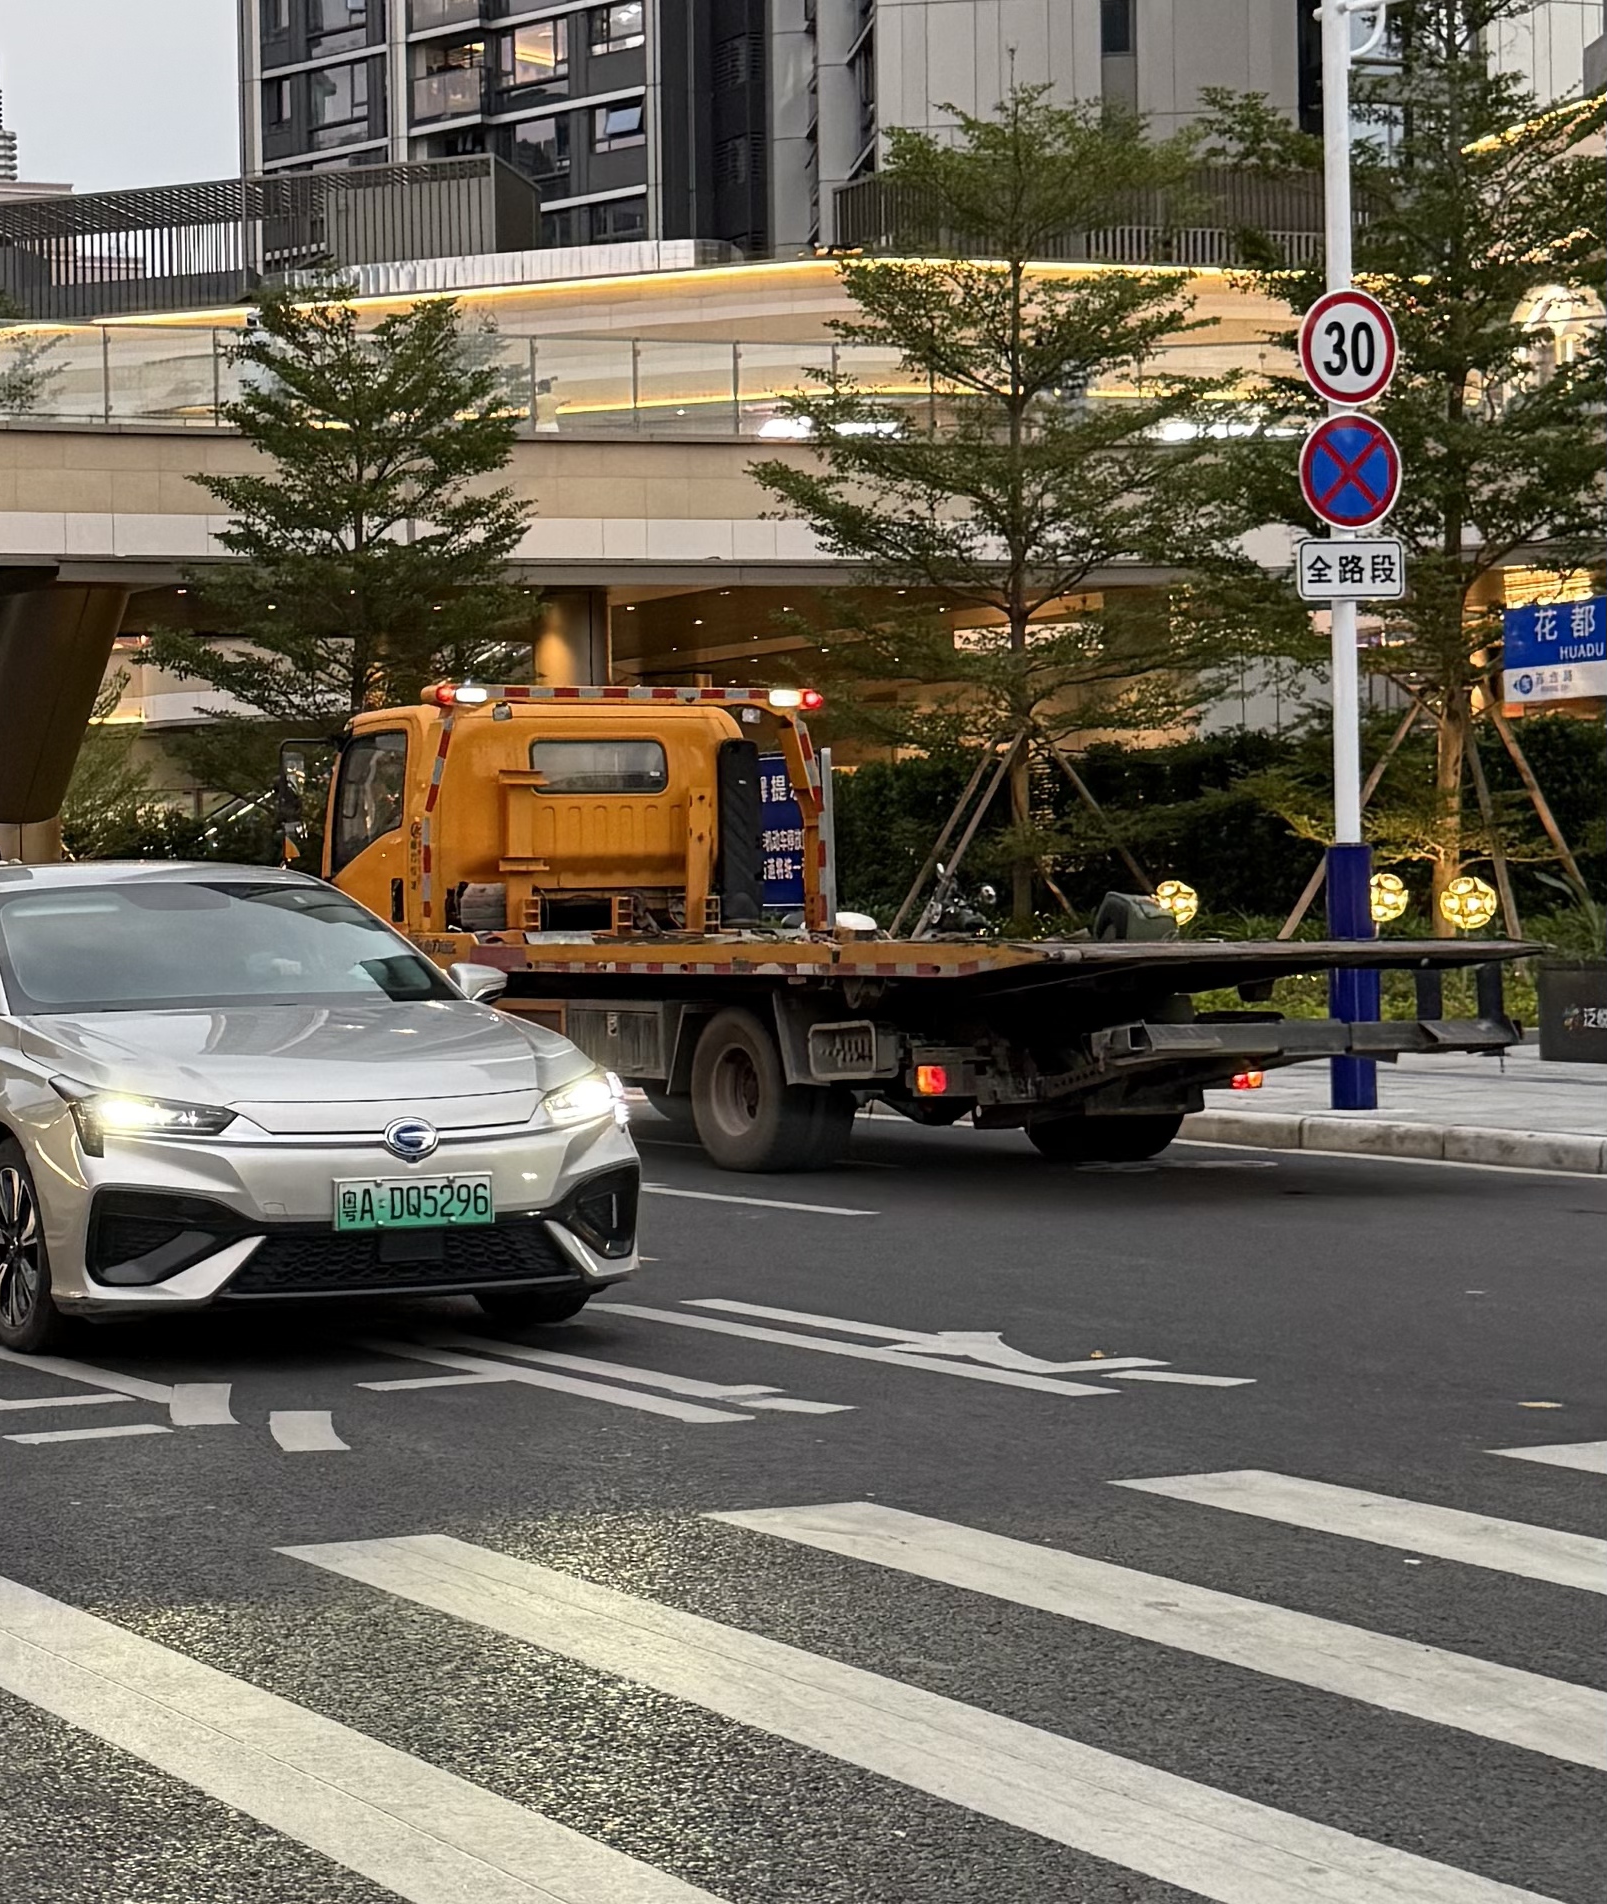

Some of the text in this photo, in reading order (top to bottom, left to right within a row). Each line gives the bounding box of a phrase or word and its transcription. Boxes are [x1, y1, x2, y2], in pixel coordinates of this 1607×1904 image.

[1322, 320, 1376, 377] 30
[1306, 553, 1397, 586] 全路段
[1534, 604, 1596, 642] 花都
[1559, 641, 1605, 660] HUADU
[389, 1182, 489, 1220] DQ5296
